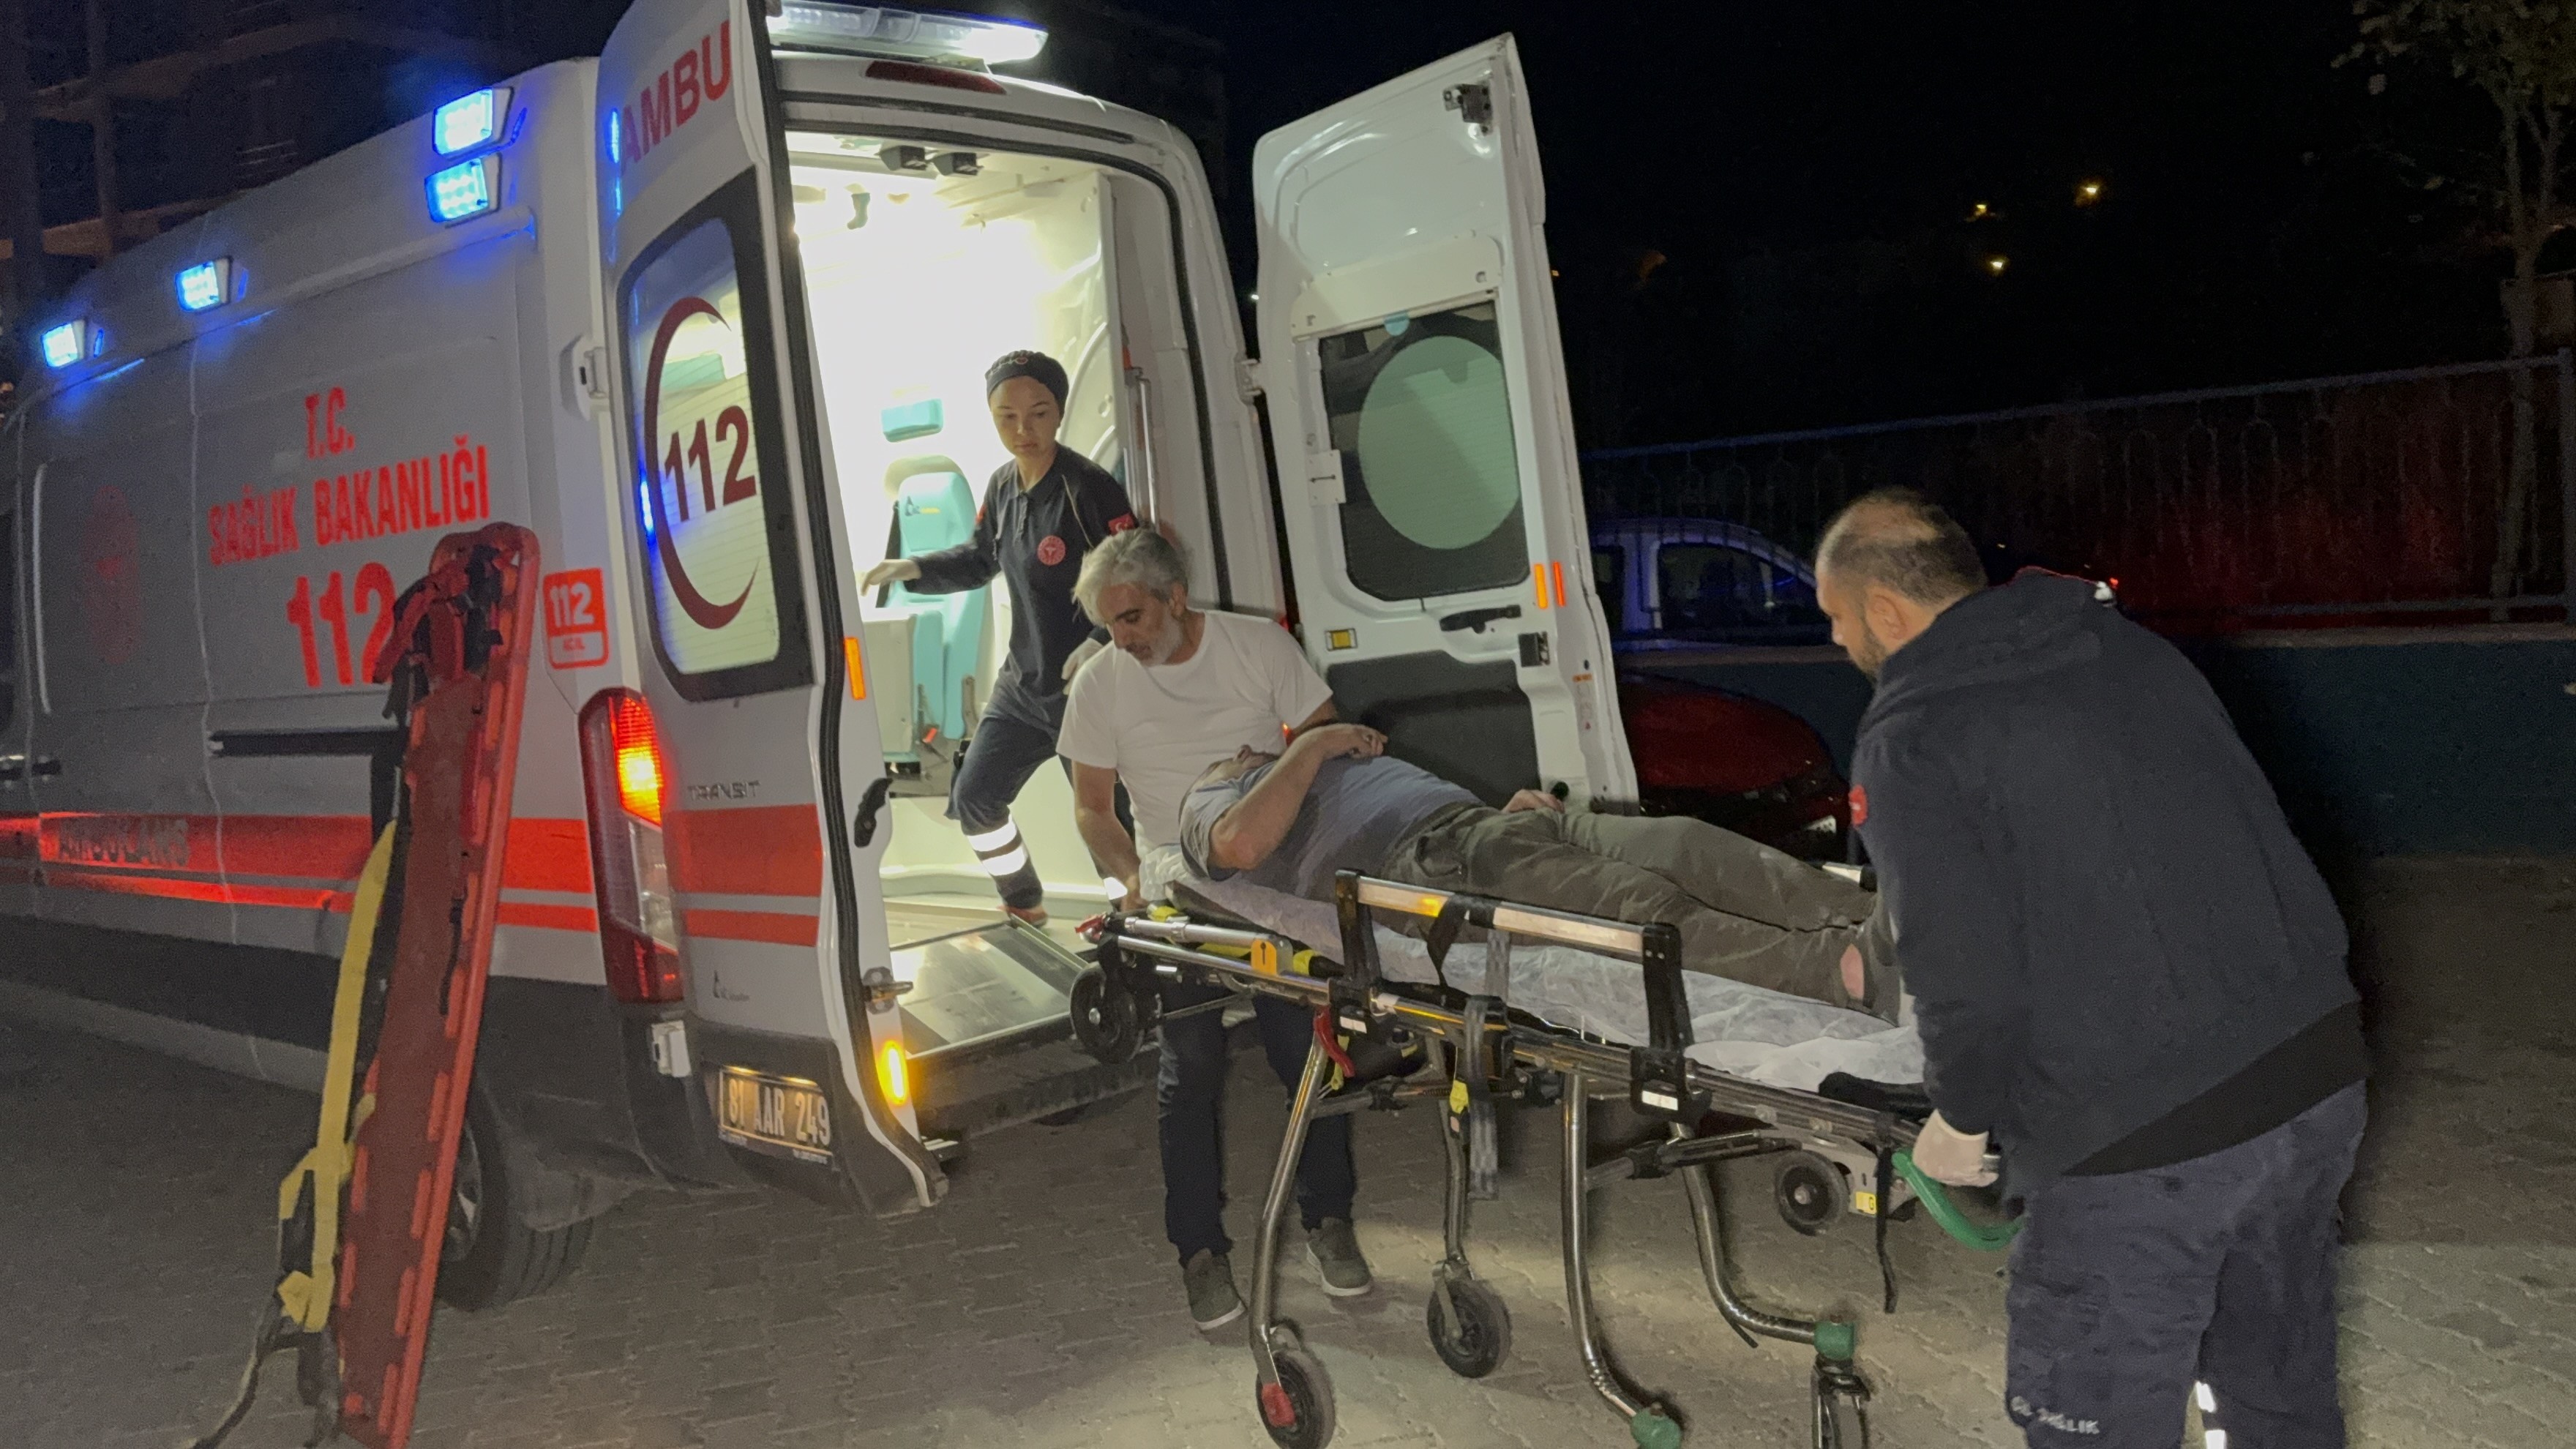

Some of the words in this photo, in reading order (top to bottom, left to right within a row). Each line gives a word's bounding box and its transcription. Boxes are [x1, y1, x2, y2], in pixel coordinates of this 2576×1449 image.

[622, 19, 731, 174] AMBU
[305, 386, 356, 458] T.C.
[664, 405, 757, 523] 112
[208, 484, 300, 566] SAĞLIK
[314, 435, 490, 546] BAKANLIĞI
[286, 561, 397, 688] 112
[549, 582, 596, 628] 112
[728, 1078, 744, 1129] 81
[753, 1082, 785, 1137] AAR
[795, 1091, 831, 1147] 249
